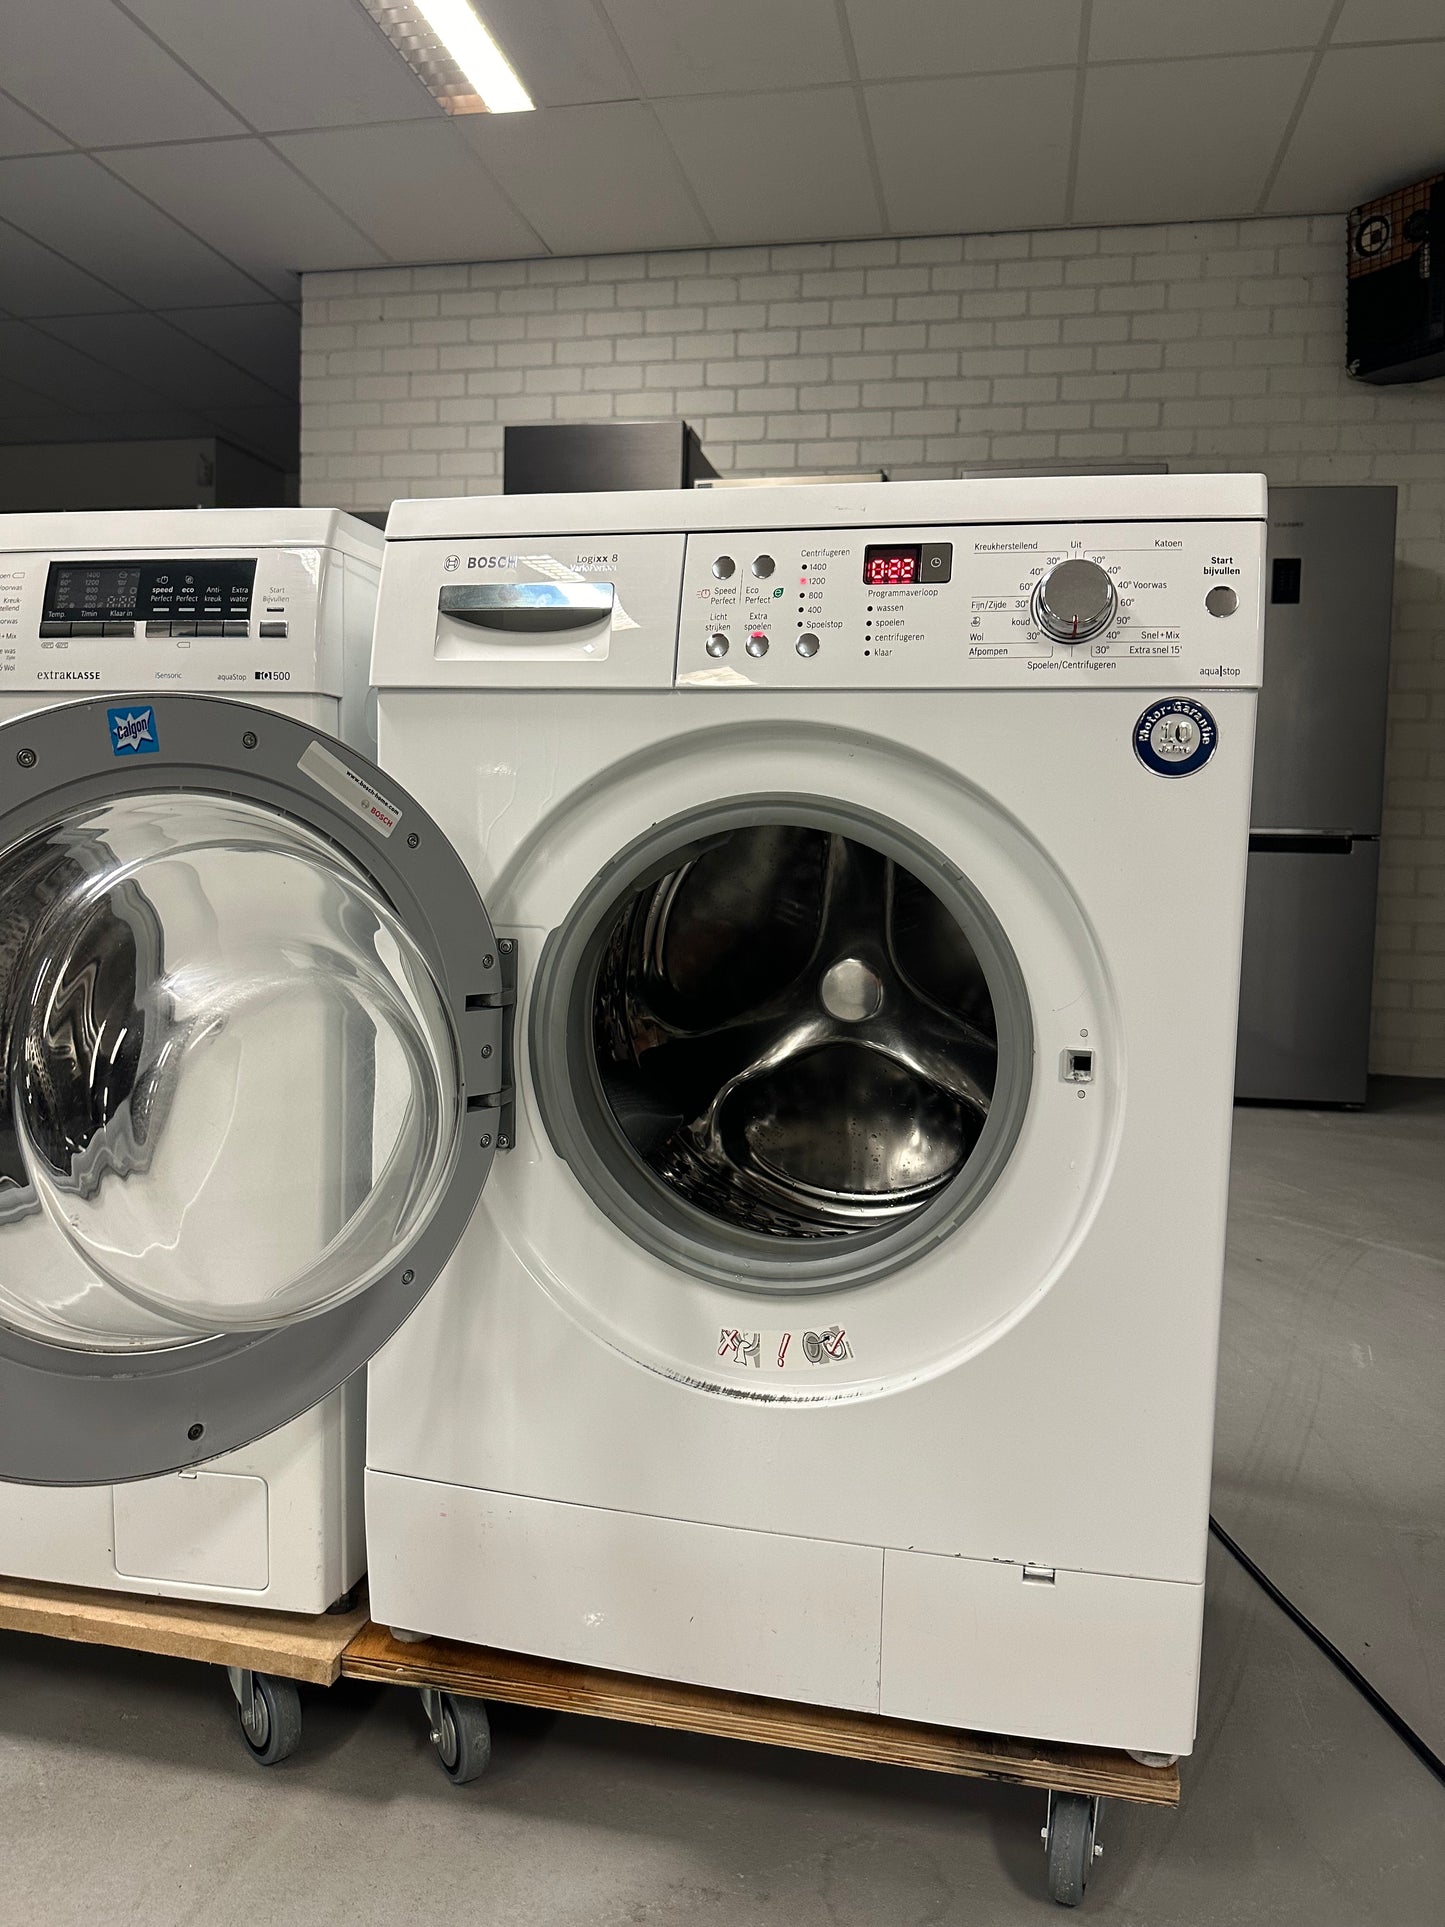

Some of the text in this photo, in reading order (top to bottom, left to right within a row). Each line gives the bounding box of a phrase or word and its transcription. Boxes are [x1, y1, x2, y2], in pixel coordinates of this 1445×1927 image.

[974, 542, 1038, 550] Kreukherstellend
[1154, 540, 1183, 548] Katoen
[801, 549, 850, 558] Centrifugeren
[467, 556, 518, 569] BOSCH
[576, 553, 618, 564] Logixx 8
[1046, 557, 1060, 565] 30°
[1211, 556, 1233, 565] Start
[809, 563, 827, 571] 1400
[1029, 567, 1044, 575] 40°
[1106, 566, 1121, 574] 40°
[1203, 566, 1241, 576] bijvullen
[808, 577, 826, 585] 1200
[1117, 581, 1167, 589] 40° Voorwas
[152, 586, 174, 594] speed
[231, 586, 249, 594] Extra
[714, 587, 737, 596] Speed
[745, 586, 759, 594] Eco
[868, 588, 939, 599] Programmaverloop
[262, 595, 290, 603] Bijvullen
[710, 597, 736, 605] Perfect
[745, 596, 771, 604] Perfect
[1120, 599, 1135, 607] 60°
[876, 604, 904, 612] wassen
[971, 600, 1029, 610] Fijn/Zijde 30°
[48, 611, 65, 619] Temp.
[710, 613, 728, 621] Licht
[749, 612, 768, 620] Extra
[875, 619, 905, 628] spoelen
[1011, 618, 1030, 626] koud
[1116, 616, 1131, 624] 90°
[705, 624, 731, 632] strijken
[744, 622, 772, 631] spoelen
[806, 620, 843, 629] Spoelstop
[874, 633, 925, 642] centrifugeren
[969, 632, 1041, 641] Wol 30°
[1106, 631, 1120, 639] 40°
[874, 649, 892, 657] klaar
[969, 648, 1008, 656] Afpompen
[1095, 646, 1110, 654] 30°
[1129, 646, 1151, 654] Extra
[1152, 645, 1169, 654] snel
[1027, 660, 1116, 671] Spoelen/Centrifugeren
[37, 670, 101, 681] extraKLASSE
[217, 673, 247, 682] aquaStop
[1138, 701, 1214, 745] Motor-Garantie
[116, 719, 148, 740] Calgon
[1160, 720, 1193, 743] 10
[346, 770, 400, 816] www.bosch-home.com
[370, 807, 393, 828] BOSCH
